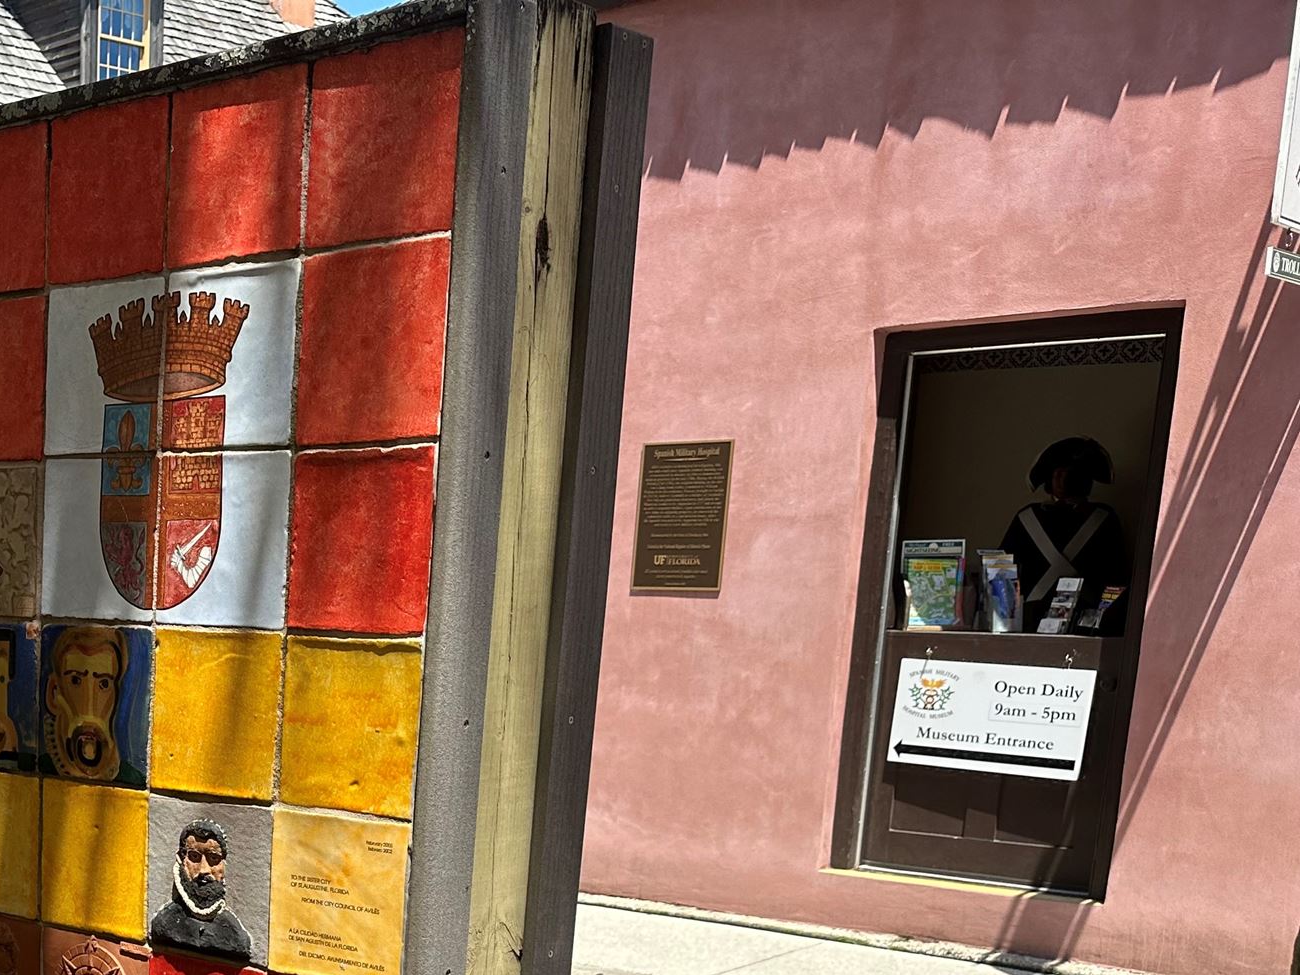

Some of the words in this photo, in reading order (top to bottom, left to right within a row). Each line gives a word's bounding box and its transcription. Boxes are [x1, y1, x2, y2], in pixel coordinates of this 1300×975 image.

[654, 554, 667, 566] UF
[667, 557, 700, 566] FLORIDA
[994, 680, 1037, 698] Open
[1042, 683, 1084, 702] Daily
[994, 703, 1026, 718] 9am
[1041, 706, 1077, 723] 5pm
[916, 726, 980, 744] Museum
[984, 732, 1055, 751] Entrance
[330, 887, 350, 895] FLORIDA
[301, 896, 316, 905] FROM
[338, 943, 358, 952] FLORIDA
